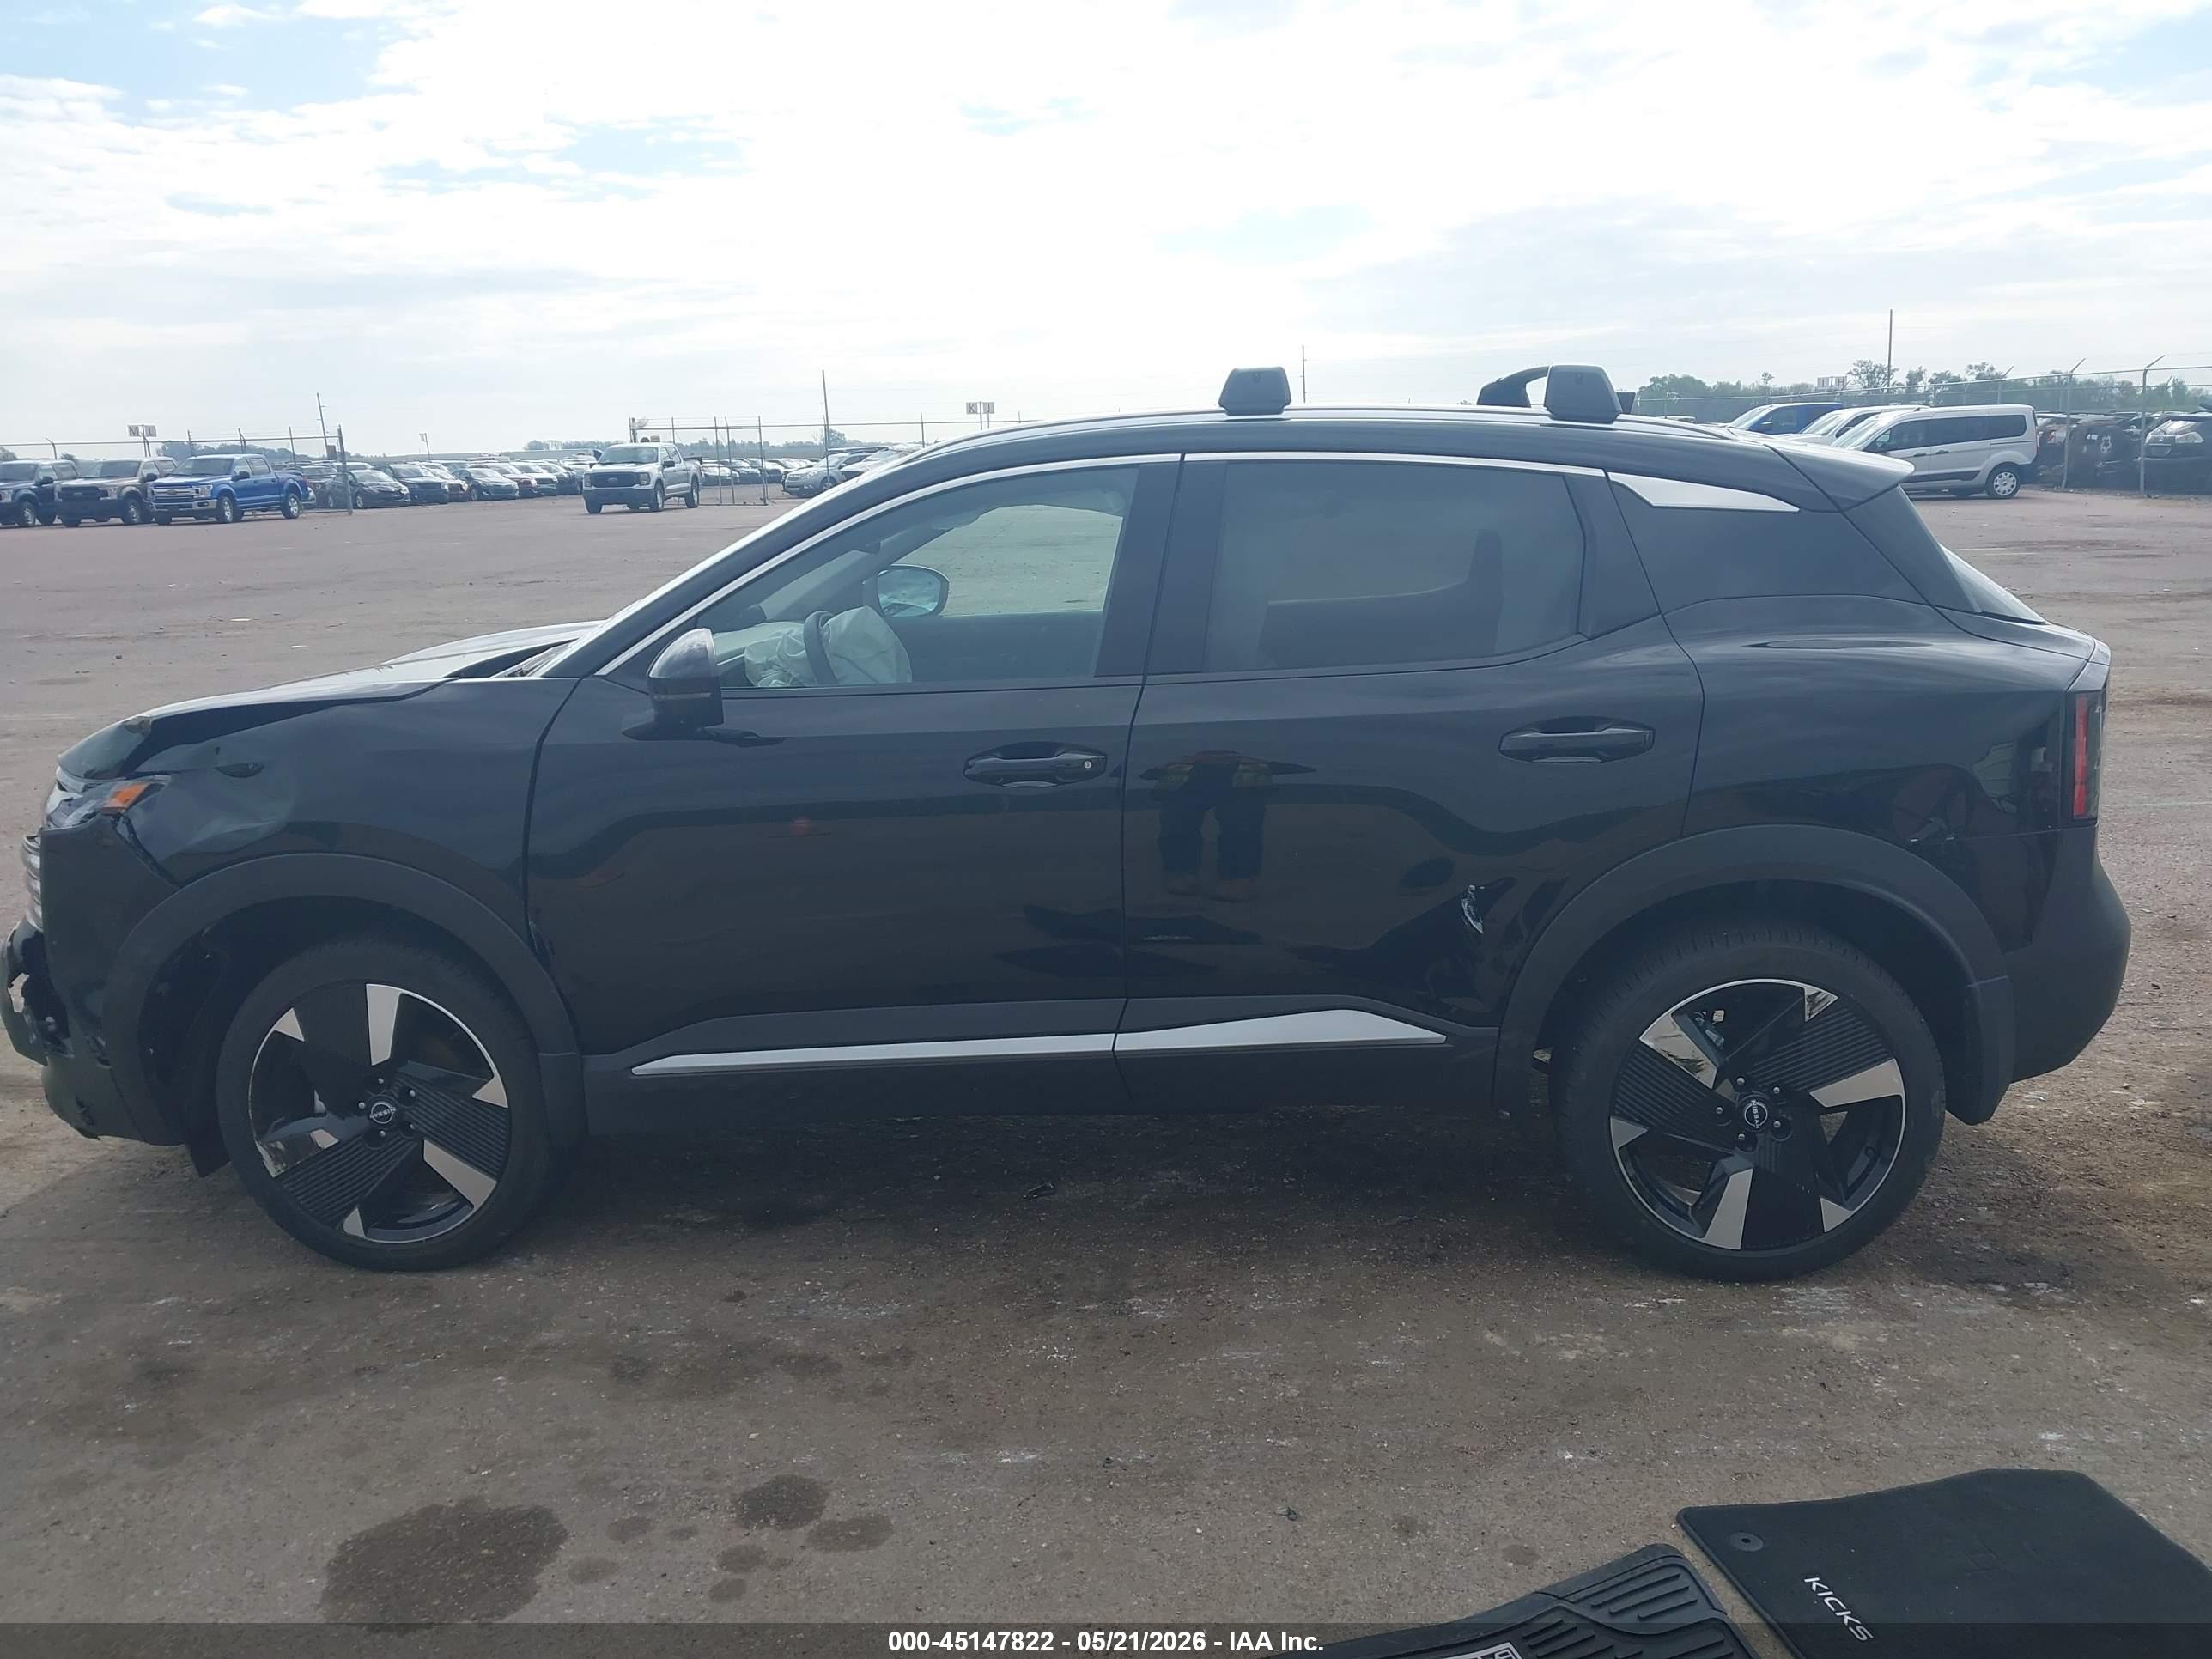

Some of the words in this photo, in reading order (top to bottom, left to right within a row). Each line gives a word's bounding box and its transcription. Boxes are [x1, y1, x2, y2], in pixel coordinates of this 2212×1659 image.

[129, 425, 139, 436] M
[1751, 1099, 1760, 1129] NISSAN
[1803, 1577, 1874, 1641] KICKS
